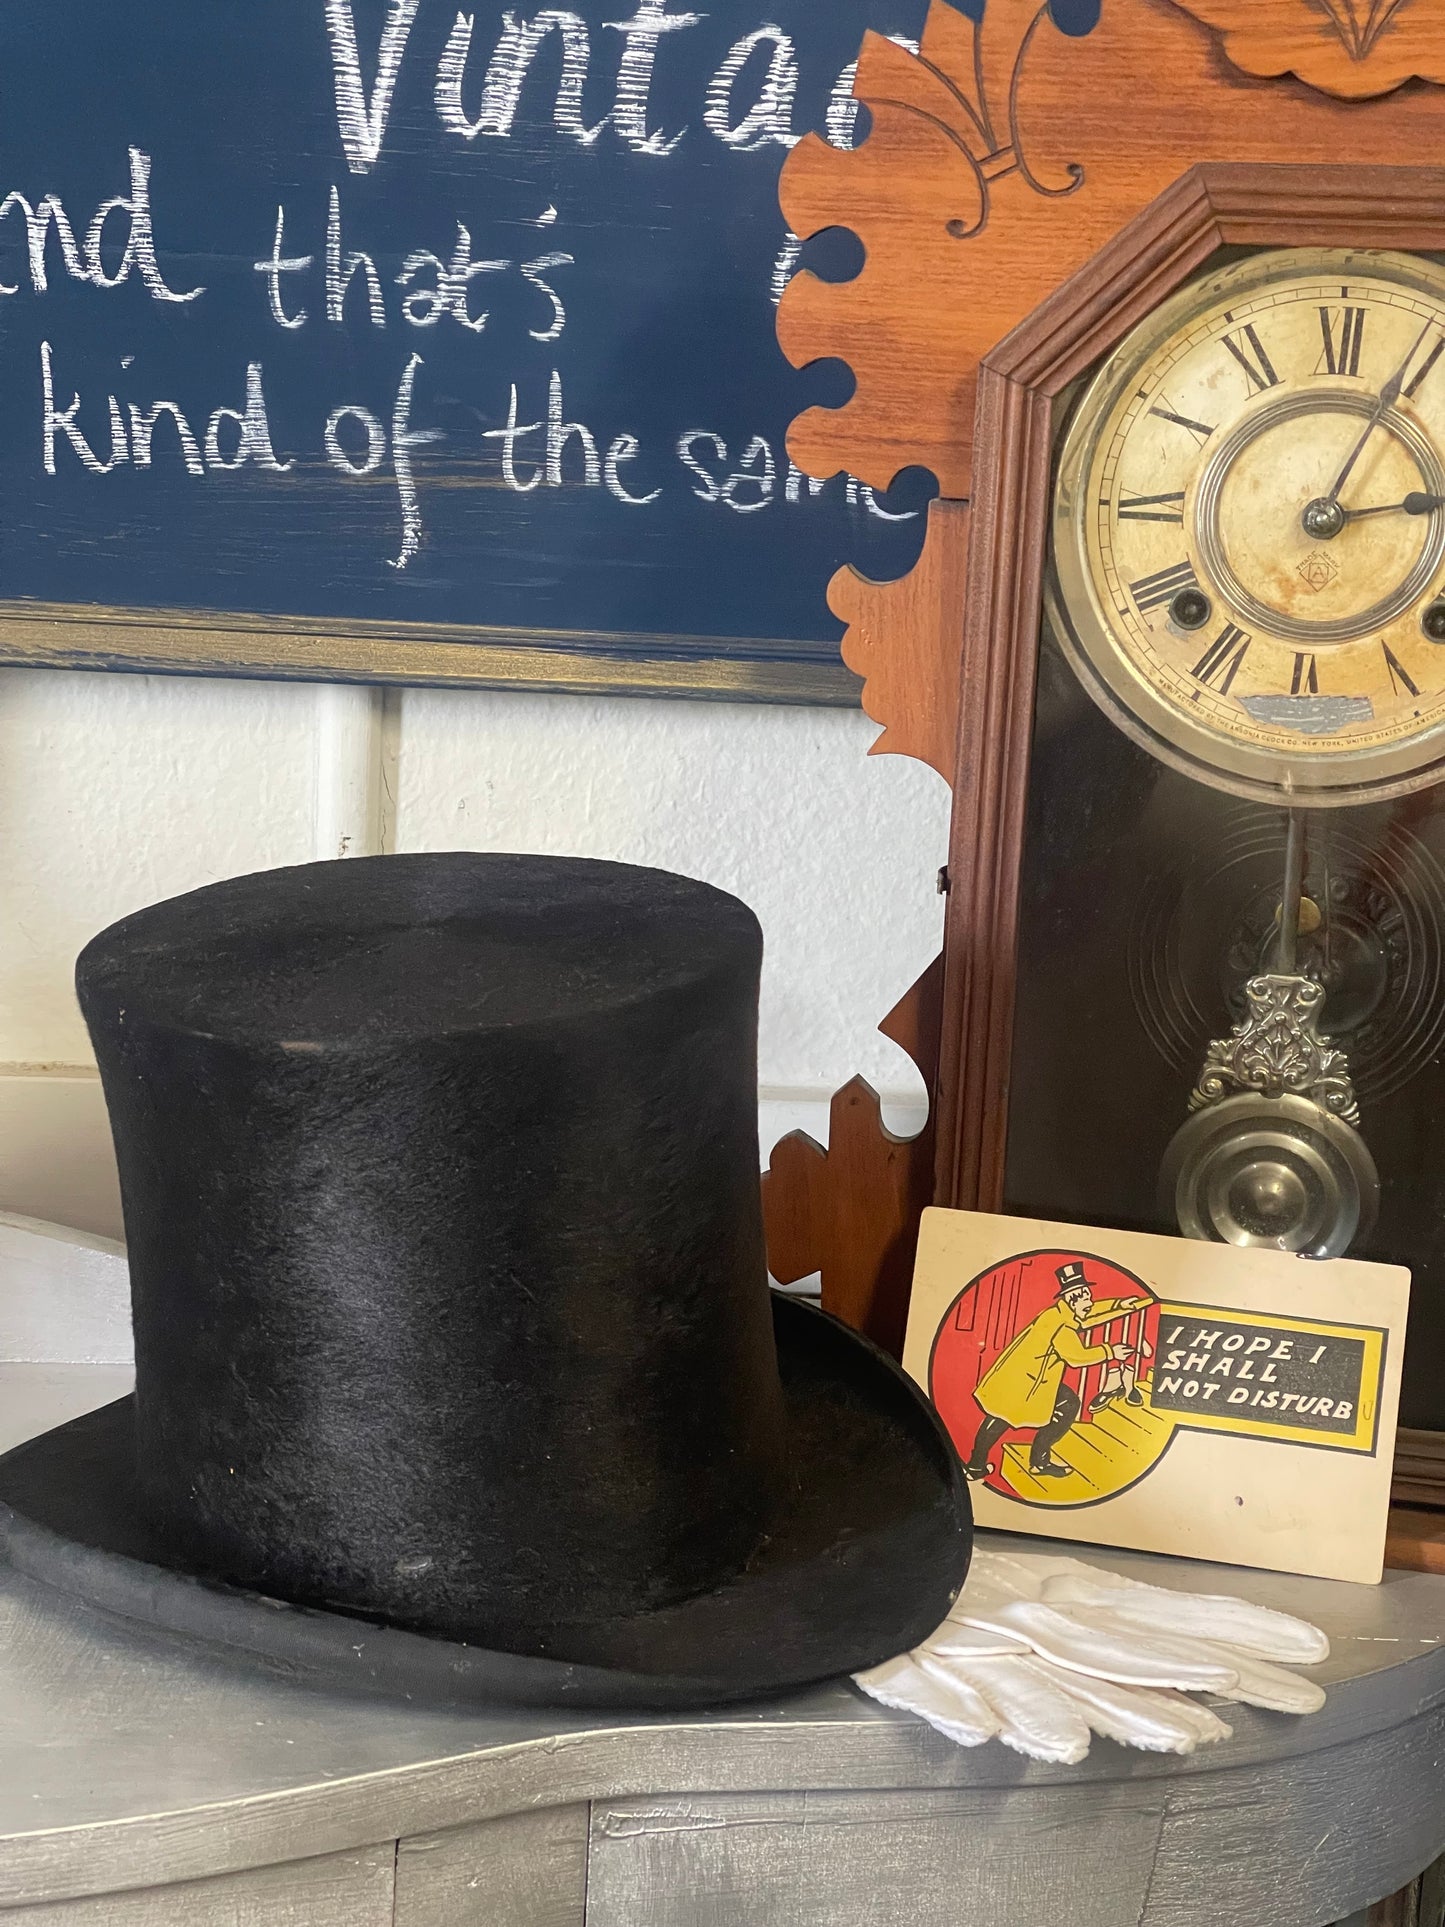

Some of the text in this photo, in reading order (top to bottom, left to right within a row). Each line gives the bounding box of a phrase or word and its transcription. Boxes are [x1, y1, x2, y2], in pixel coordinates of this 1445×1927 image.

[325, 0, 919, 173] Vinta
[0, 144, 207, 301] nd
[1215, 321, 1286, 401] XI
[1309, 306, 1370, 378] XII
[1144, 388, 1219, 453] X
[42, 340, 296, 475] kind
[325, 353, 447, 568] of
[482, 368, 661, 503] the
[1118, 481, 1188, 529] IX
[1186, 617, 1253, 697] VII
[1290, 650, 1319, 695] VI
[1206, 712, 1215, 720] BY
[1217, 718, 1229, 728] THE
[1230, 725, 1260, 739] ANSONIA
[1261, 734, 1285, 745] CLOCK
[1346, 735, 1373, 745] UNITED
[1376, 727, 1402, 739] STATES
[1162, 1350, 1279, 1383] SHALL
[1166, 1326, 1327, 1364] I HOPE I
[1158, 1376, 1354, 1420] NOT DISTURB
